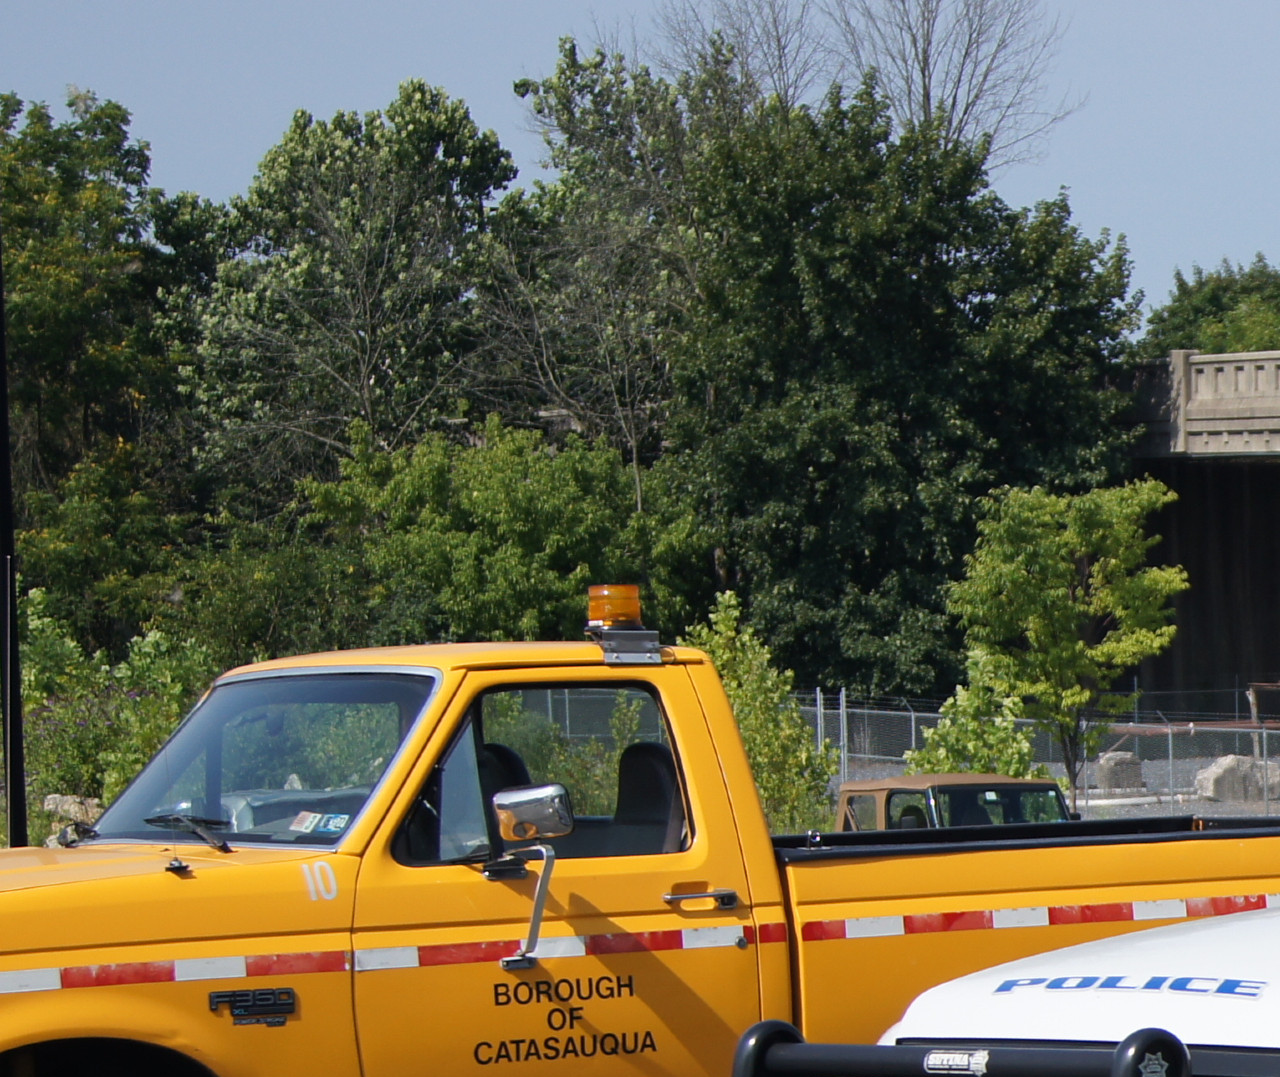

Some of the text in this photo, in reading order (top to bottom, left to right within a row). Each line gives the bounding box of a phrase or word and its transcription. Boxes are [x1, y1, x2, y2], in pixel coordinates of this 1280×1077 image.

[302, 861, 338, 901] 10
[208, 988, 296, 1011] F350
[493, 975, 635, 1007] BOROUGH
[993, 975, 1269, 999] POLICE
[547, 1006, 584, 1031] OF
[473, 1030, 658, 1066] CATASAUQUA
